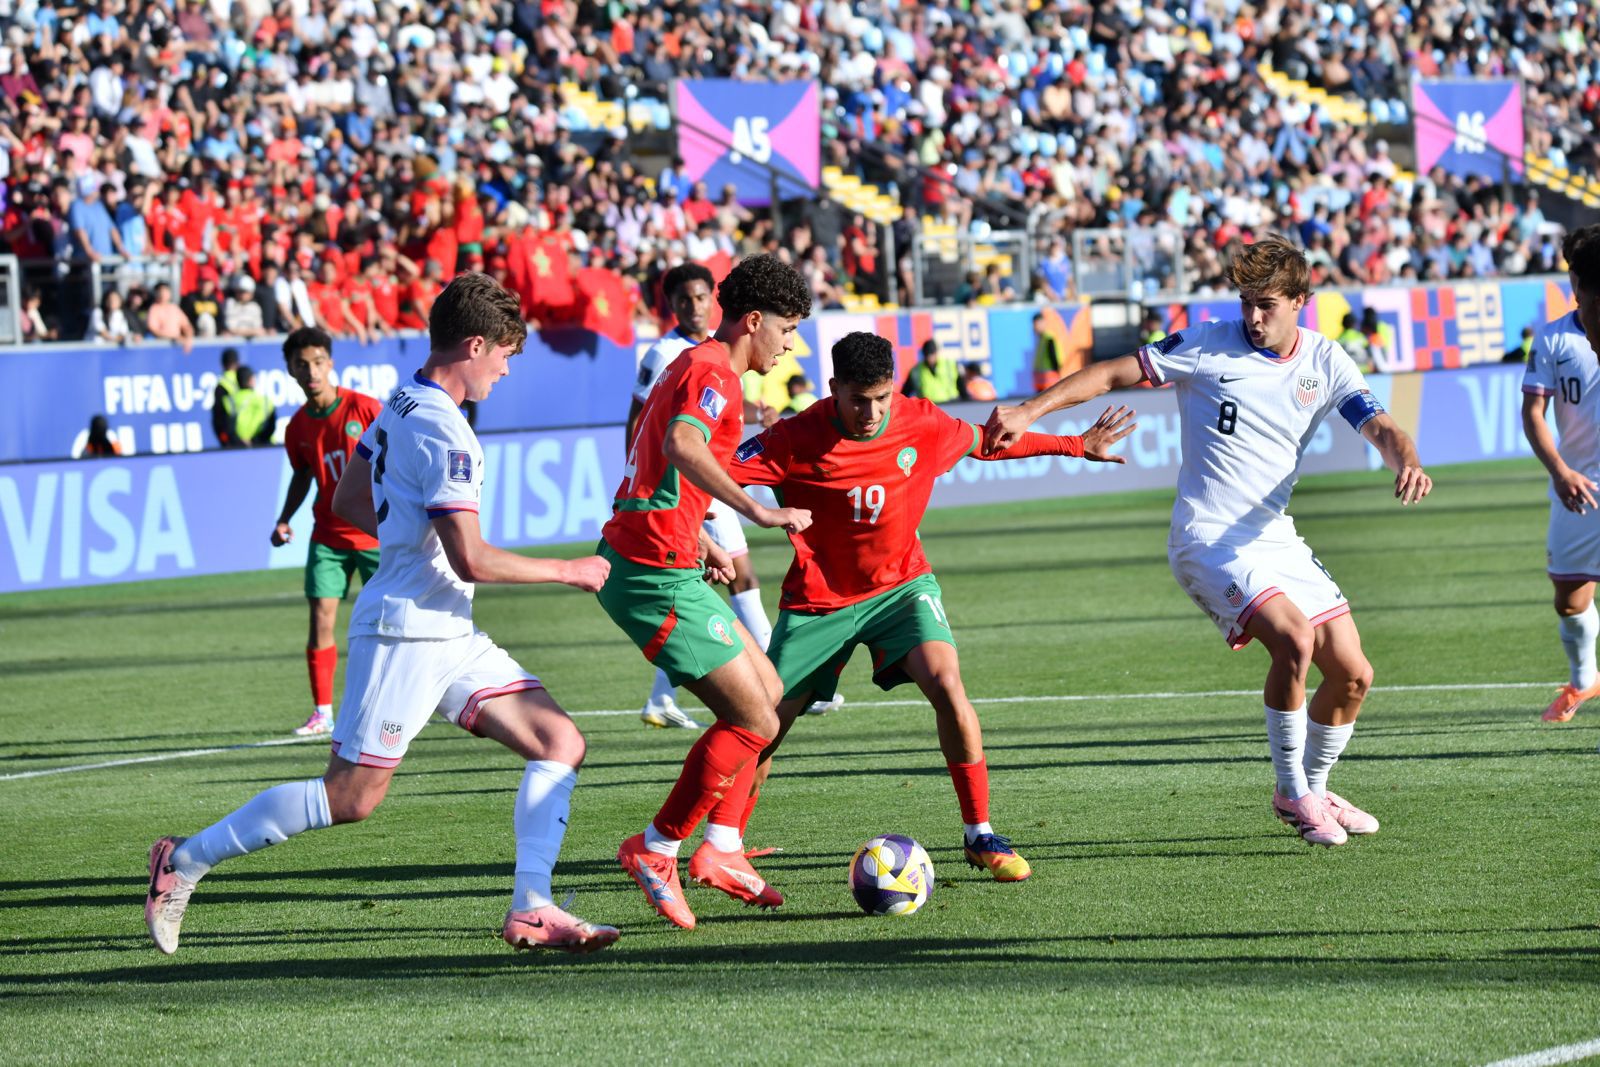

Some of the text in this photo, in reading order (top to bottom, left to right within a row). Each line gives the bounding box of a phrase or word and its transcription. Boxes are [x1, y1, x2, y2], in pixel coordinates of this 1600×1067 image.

[730, 115, 772, 164] A5
[104, 374, 171, 414] FIFA
[172, 371, 218, 412] U-2
[342, 363, 398, 401] CUP
[1300, 377, 1318, 391] USA
[1560, 376, 1581, 405] 10
[1218, 400, 1238, 435] 8
[323, 449, 347, 482] 17
[847, 484, 886, 524] 19
[0, 465, 196, 583] VISA
[1225, 583, 1238, 598] USA
[383, 722, 402, 734] USA
